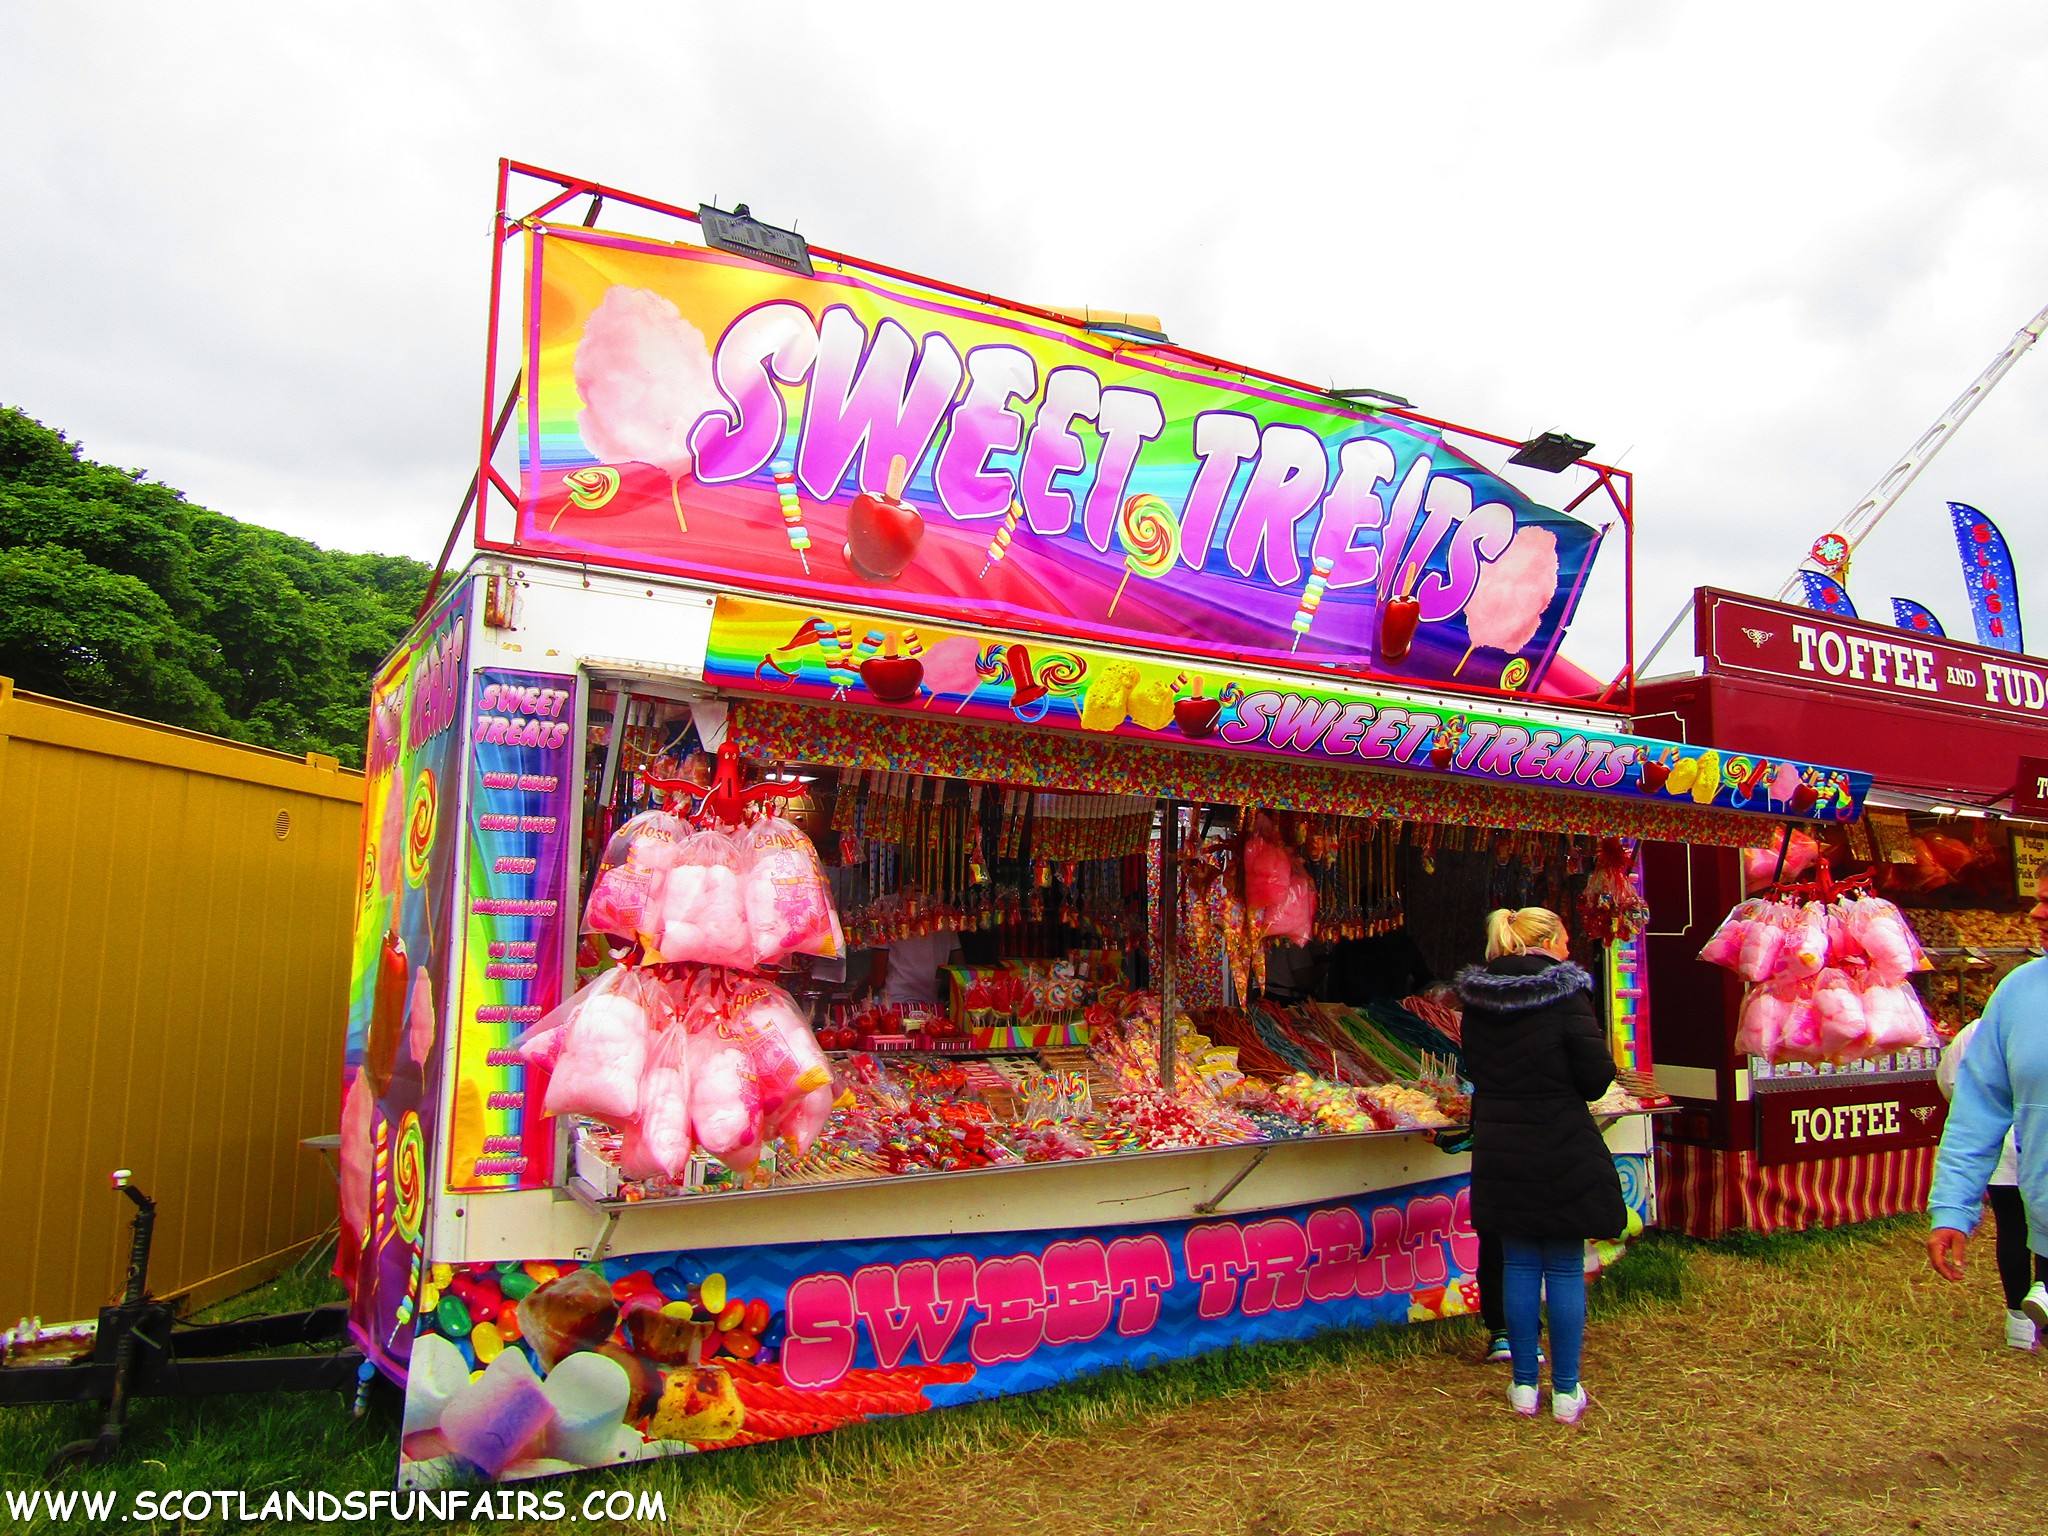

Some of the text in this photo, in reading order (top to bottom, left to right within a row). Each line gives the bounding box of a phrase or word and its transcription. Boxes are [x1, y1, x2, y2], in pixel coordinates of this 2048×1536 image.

[687, 299, 1166, 553] SWEET
[1972, 523, 2005, 637] SLUSH
[1792, 624, 2048, 710] TOFFEE AND FUD
[478, 684, 569, 717] SWEET
[475, 715, 570, 749] TREATS
[1220, 690, 1635, 787] SWEET TREATS
[482, 772, 518, 790] CANDY
[480, 813, 557, 833] CINDER TOFFEE
[493, 857, 537, 874] SWEETS
[472, 896, 558, 917] MARSHMALLOWS
[488, 940, 538, 959] OLD TYME
[475, 1004, 543, 1023] CANDY FLOSS
[486, 1091, 525, 1110] FUDGE
[1791, 1101, 1900, 1144] TOFFEE
[483, 1134, 522, 1154] SUGAR
[473, 1156, 528, 1177] DUMMIES
[780, 1232, 1174, 1390] SWEET
